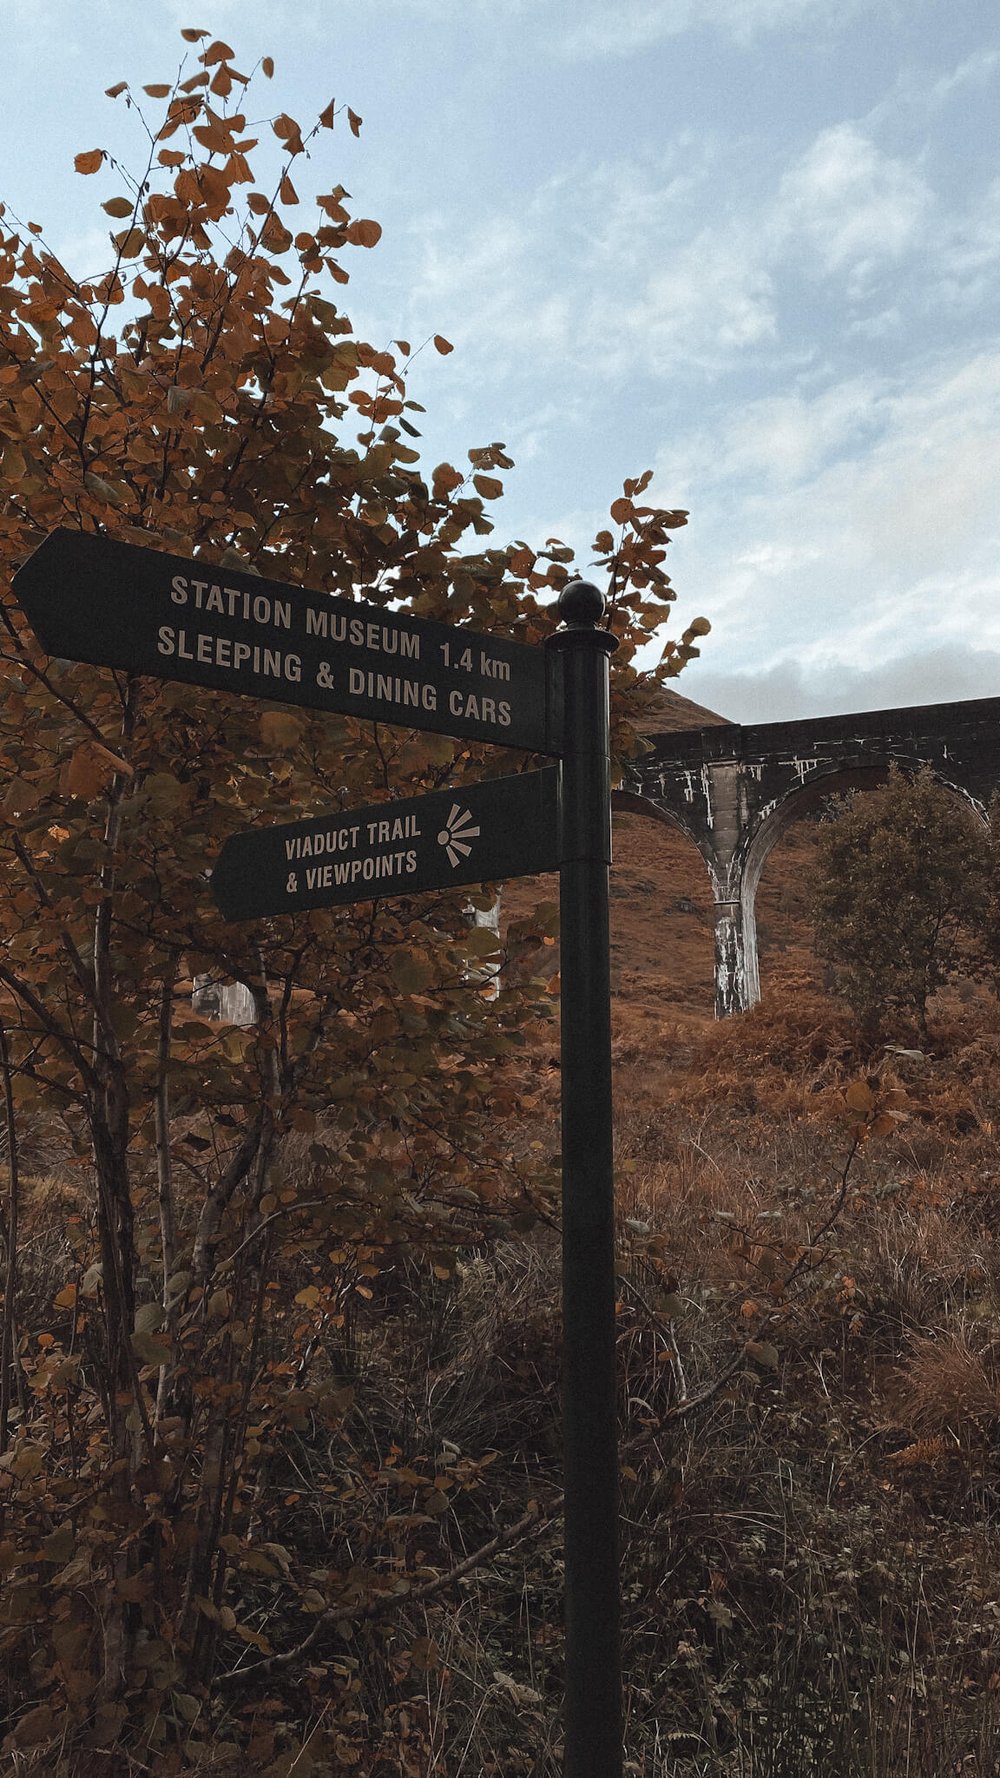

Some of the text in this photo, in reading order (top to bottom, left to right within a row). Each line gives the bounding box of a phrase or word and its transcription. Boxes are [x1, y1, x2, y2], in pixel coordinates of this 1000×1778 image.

[170, 575, 512, 682] STATION MUSEUM 1.4 km
[157, 626, 512, 726] SLEEPING & DINING CARS
[285, 815, 421, 860] VIADUCT TRAIL
[286, 850, 417, 893] & VIEWPOINTS
